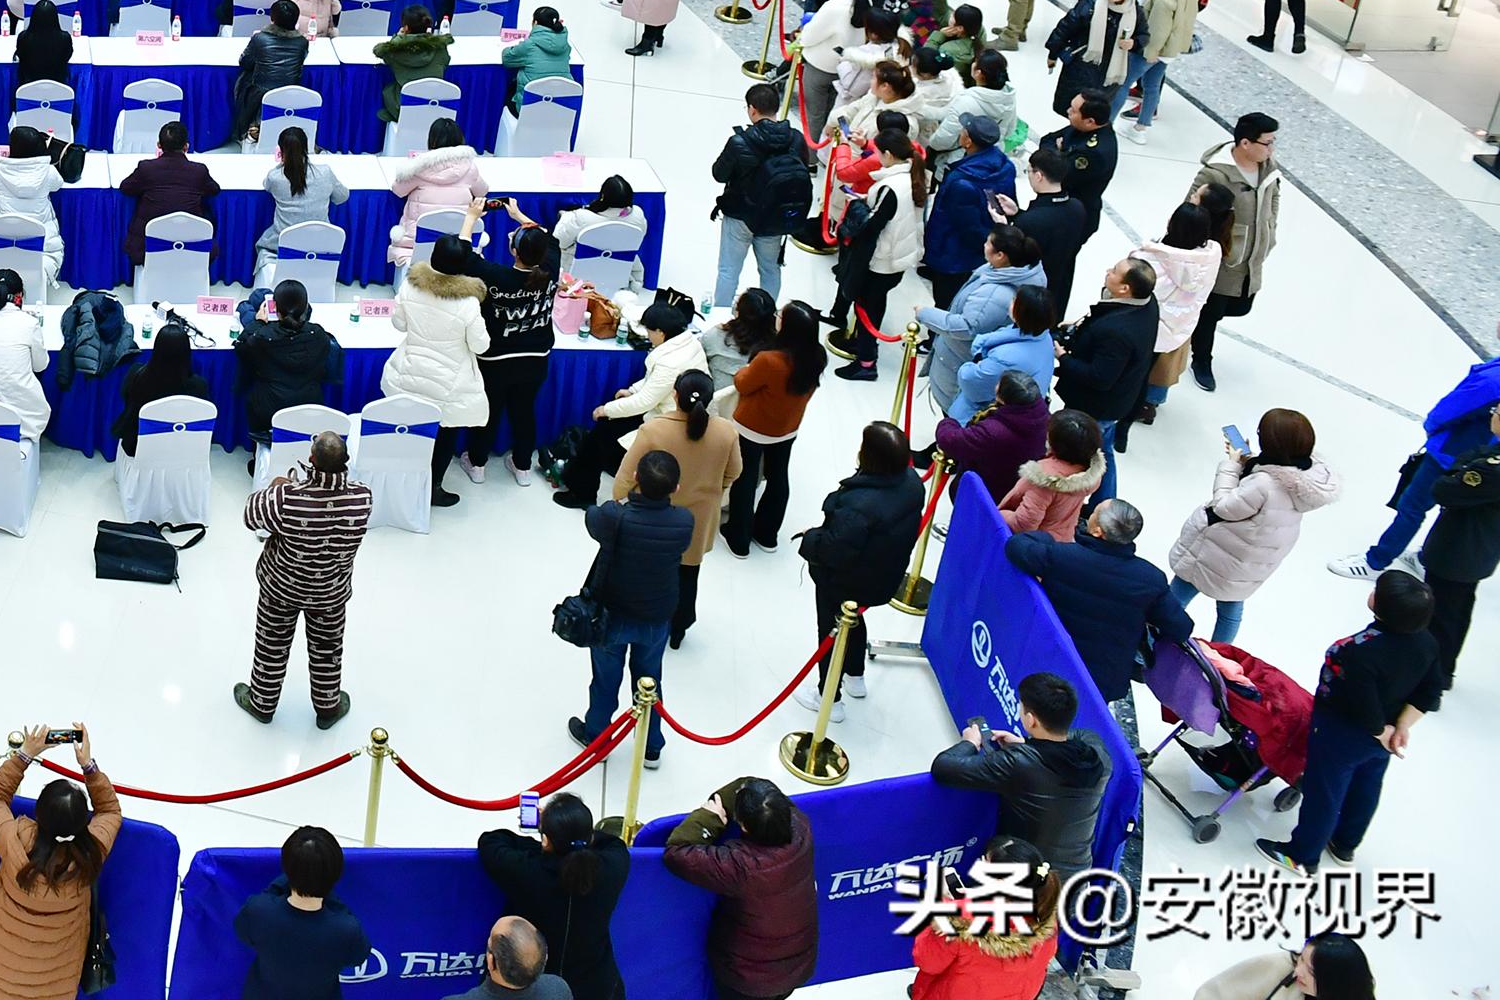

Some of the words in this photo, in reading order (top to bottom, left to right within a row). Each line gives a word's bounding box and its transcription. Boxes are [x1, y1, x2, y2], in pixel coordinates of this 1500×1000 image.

[203, 302, 229, 313] 记者席
[364, 305, 390, 315] 记者席
